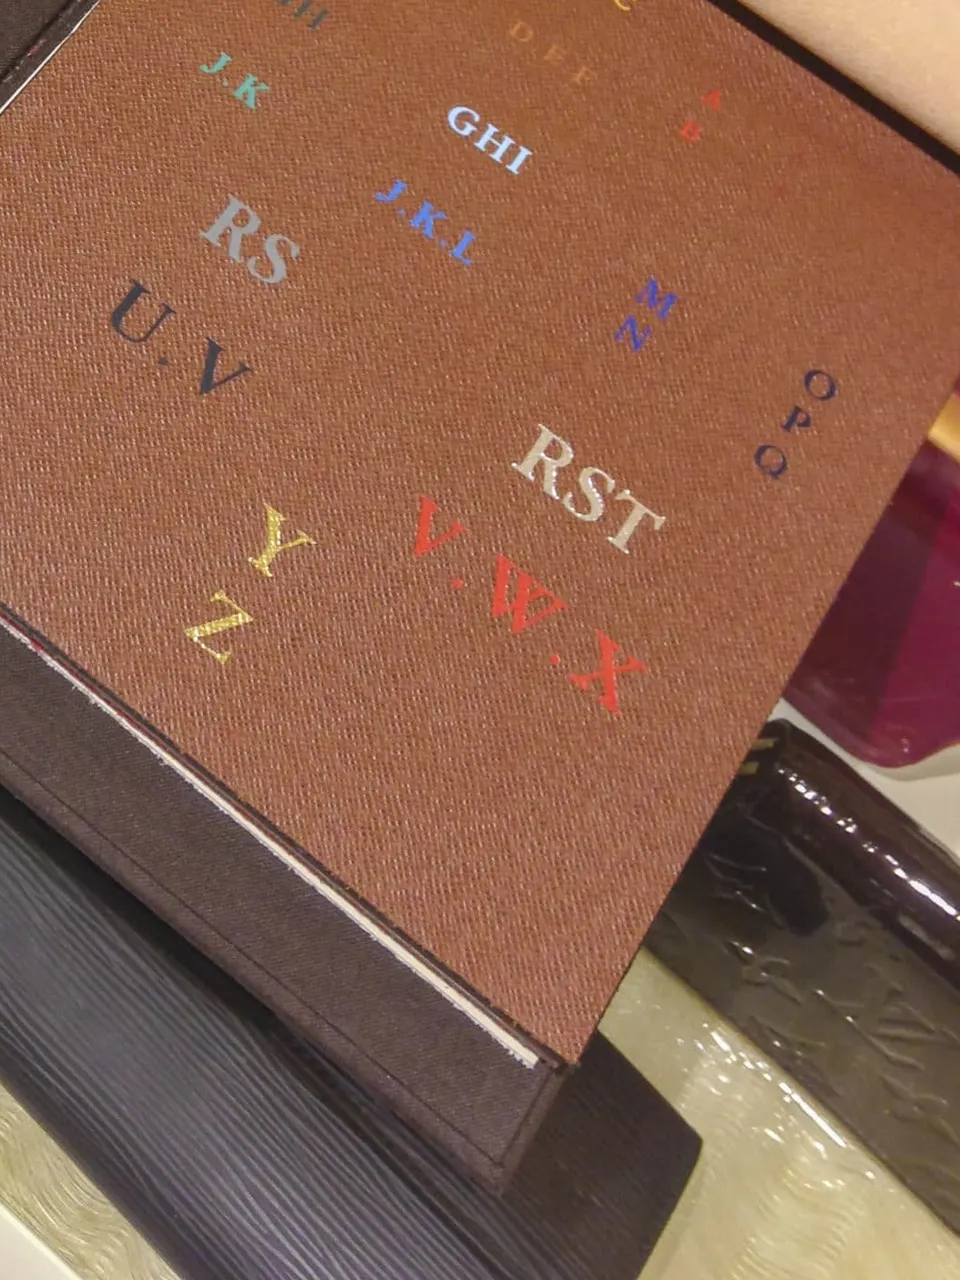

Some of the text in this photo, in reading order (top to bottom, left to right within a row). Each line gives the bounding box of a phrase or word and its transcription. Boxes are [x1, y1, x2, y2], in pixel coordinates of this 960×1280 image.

[446, 104, 534, 176] GHI
[197, 191, 301, 286] RS
[510, 422, 668, 556] RST
